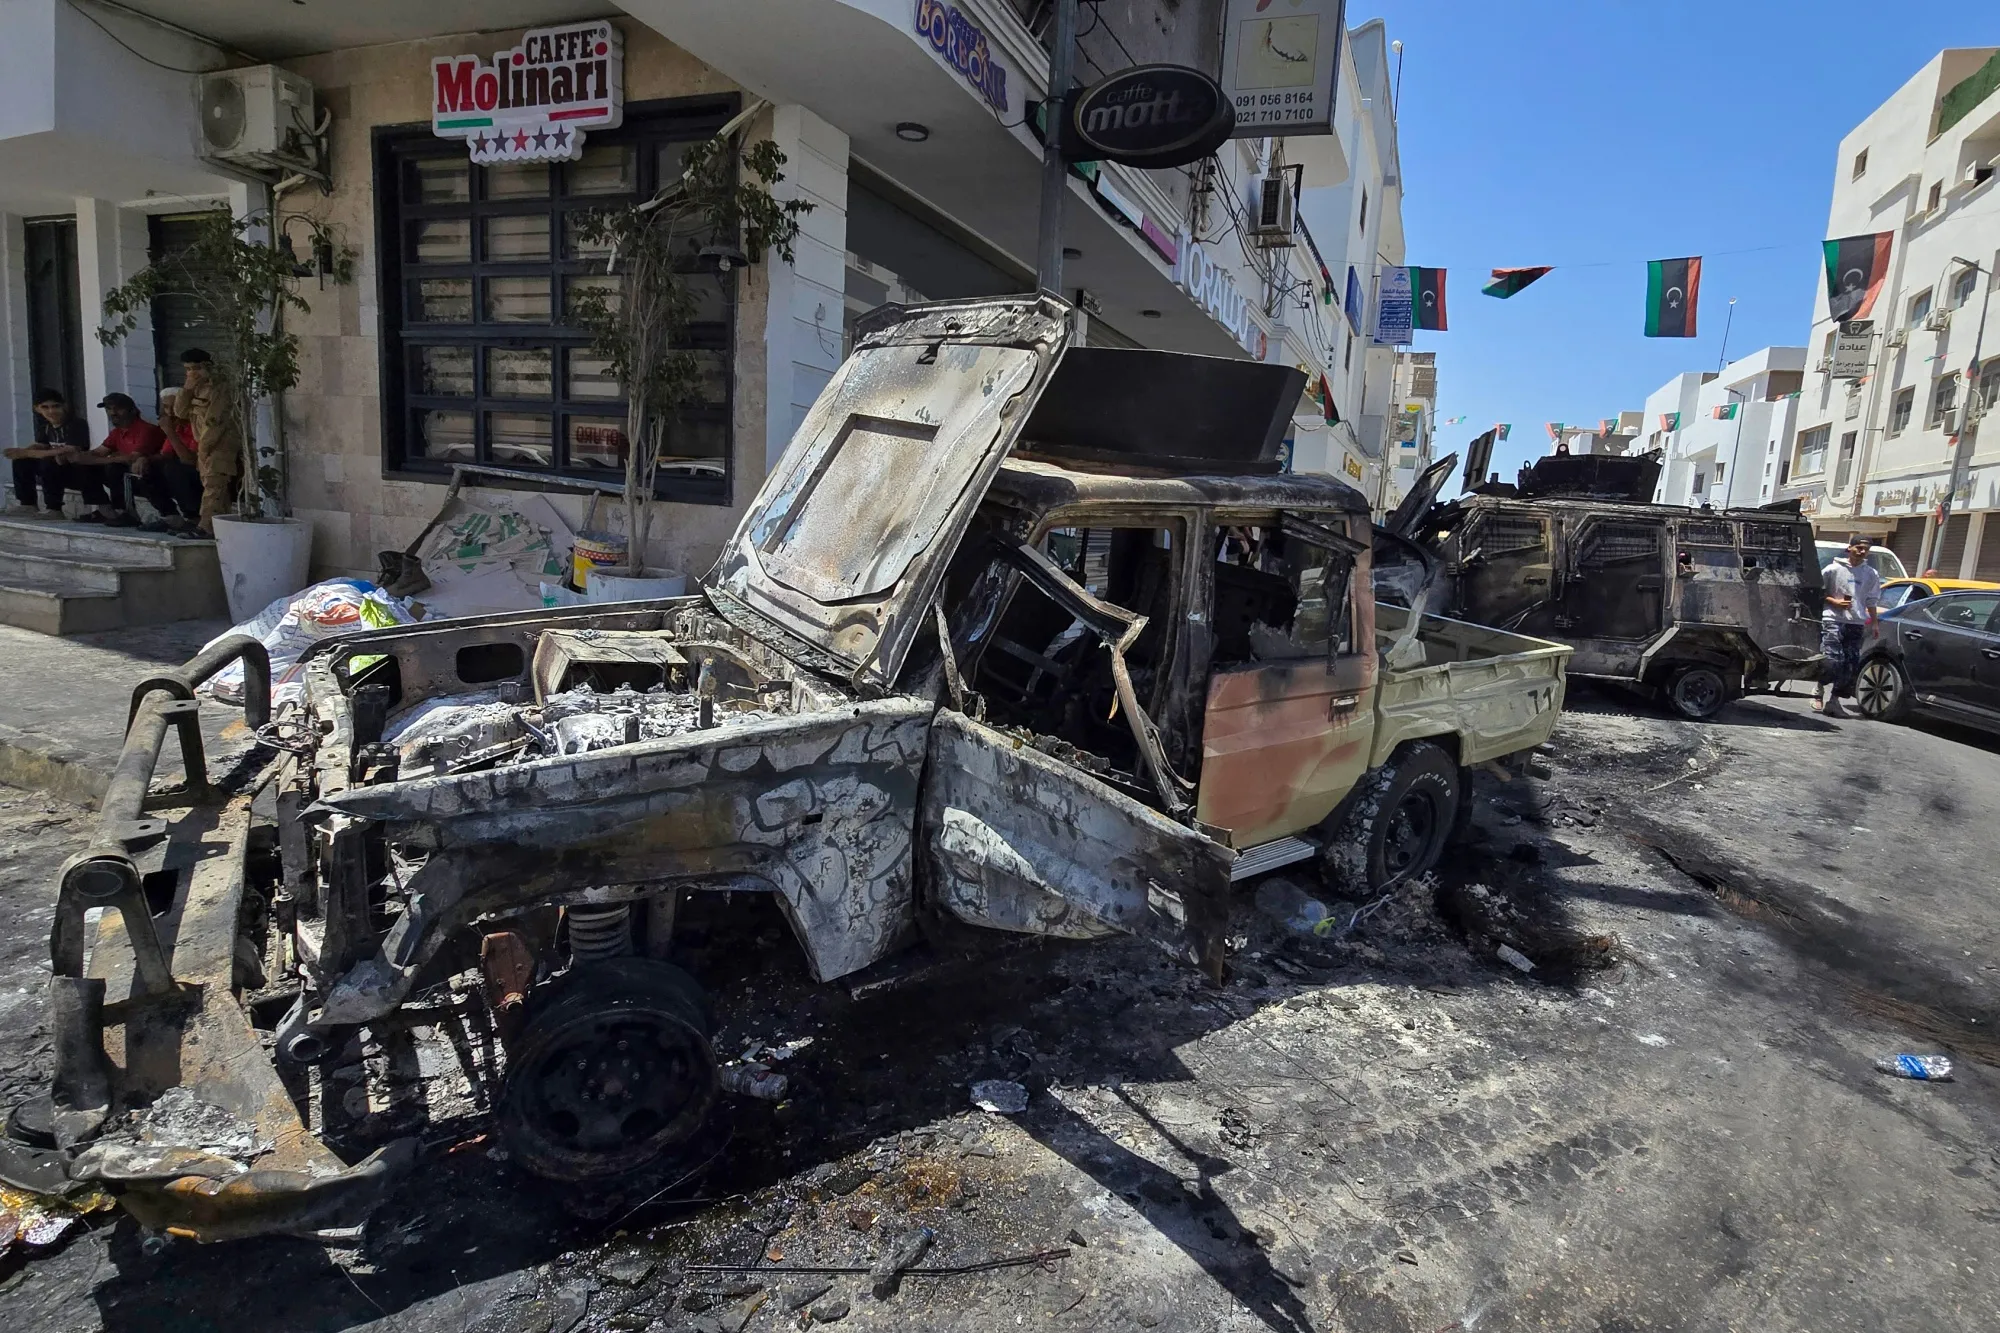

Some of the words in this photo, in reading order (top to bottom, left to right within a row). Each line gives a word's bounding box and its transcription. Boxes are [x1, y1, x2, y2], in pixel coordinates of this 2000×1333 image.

[435, 41, 609, 114] Molinari
[1235, 95, 1256, 107] 091
[1260, 94, 1281, 106] 056
[1284, 92, 1313, 104] 8164
[1236, 111, 1256, 123] 021
[1260, 110, 1281, 122] 710
[1285, 108, 1314, 121] 7100
[1838, 343, 1867, 353] عيادة
